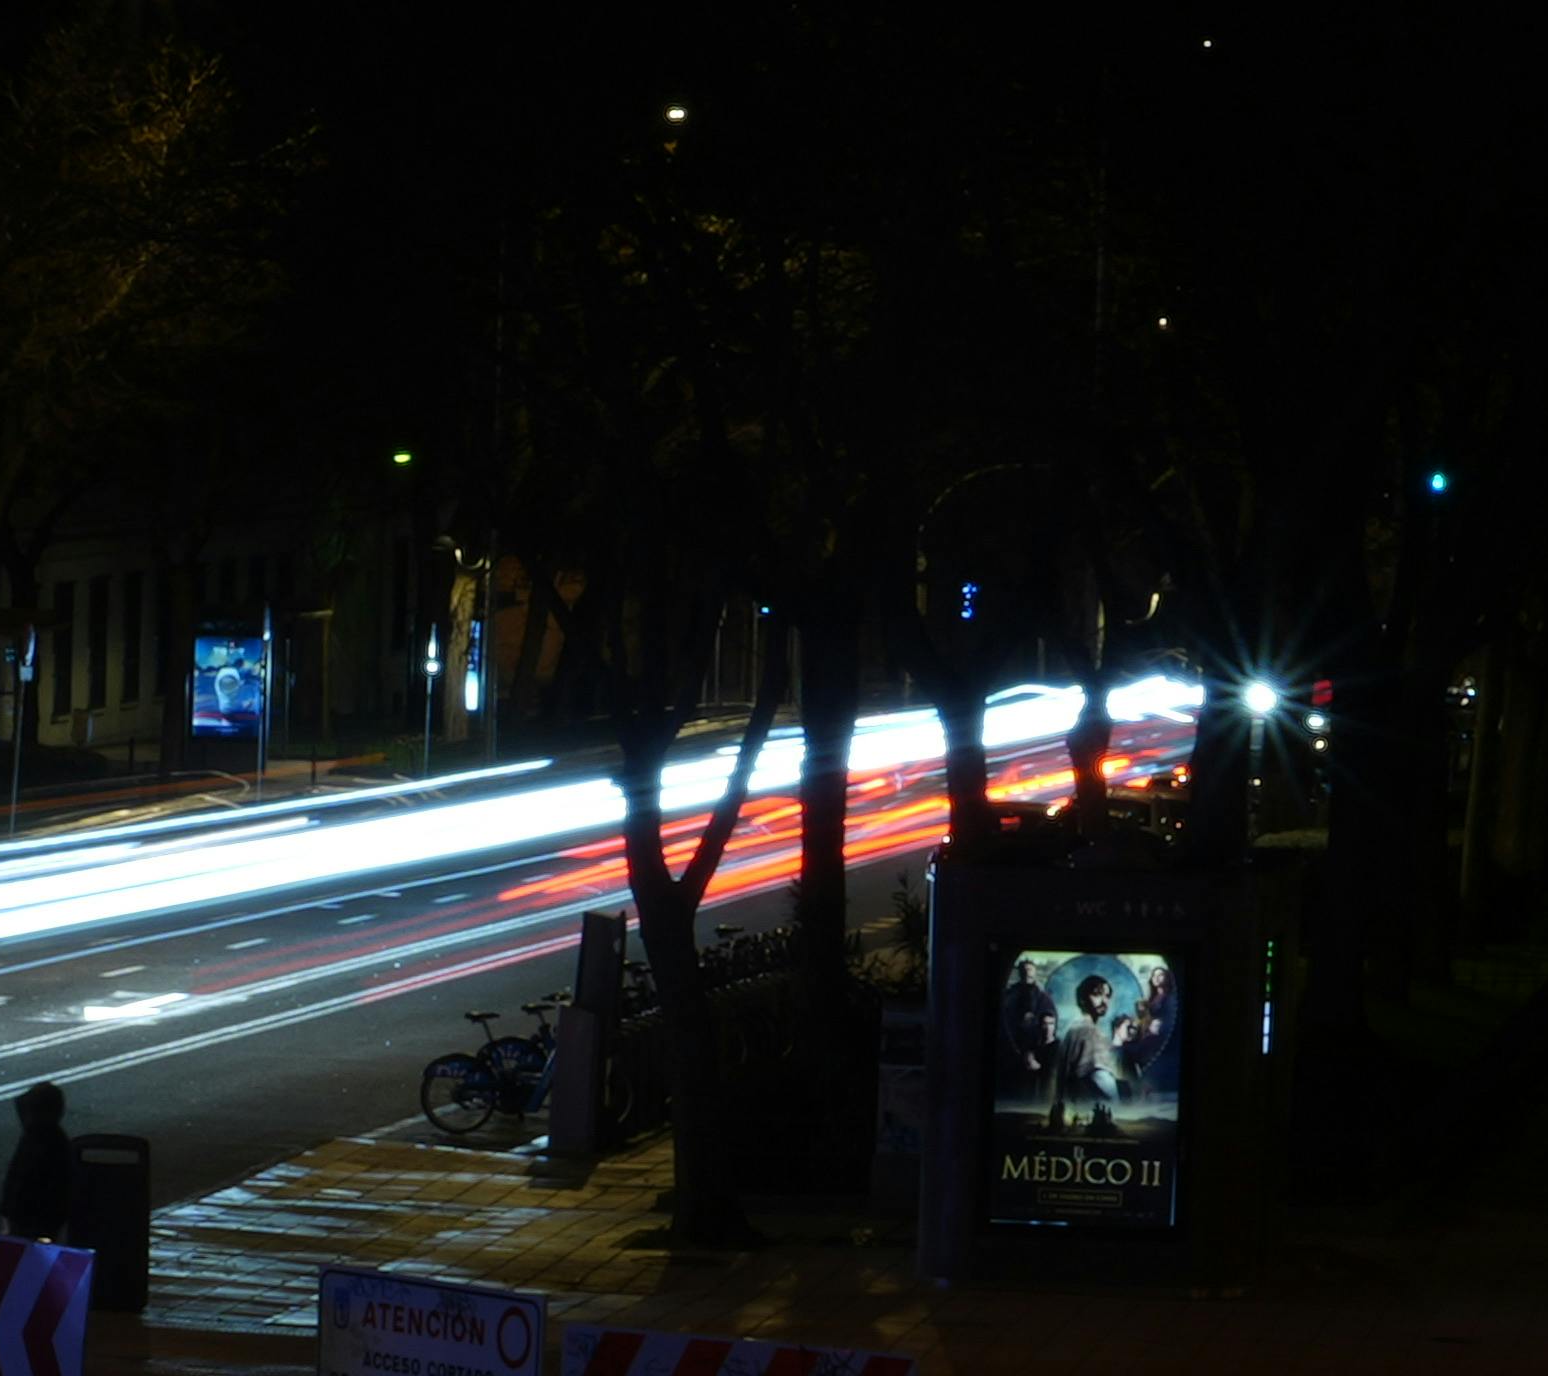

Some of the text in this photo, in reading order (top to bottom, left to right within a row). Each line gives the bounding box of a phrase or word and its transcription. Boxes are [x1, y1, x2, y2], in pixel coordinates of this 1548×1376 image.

[1001, 1151, 1162, 1188] MÉDICO II
[362, 1350, 421, 1376] ACCESO
